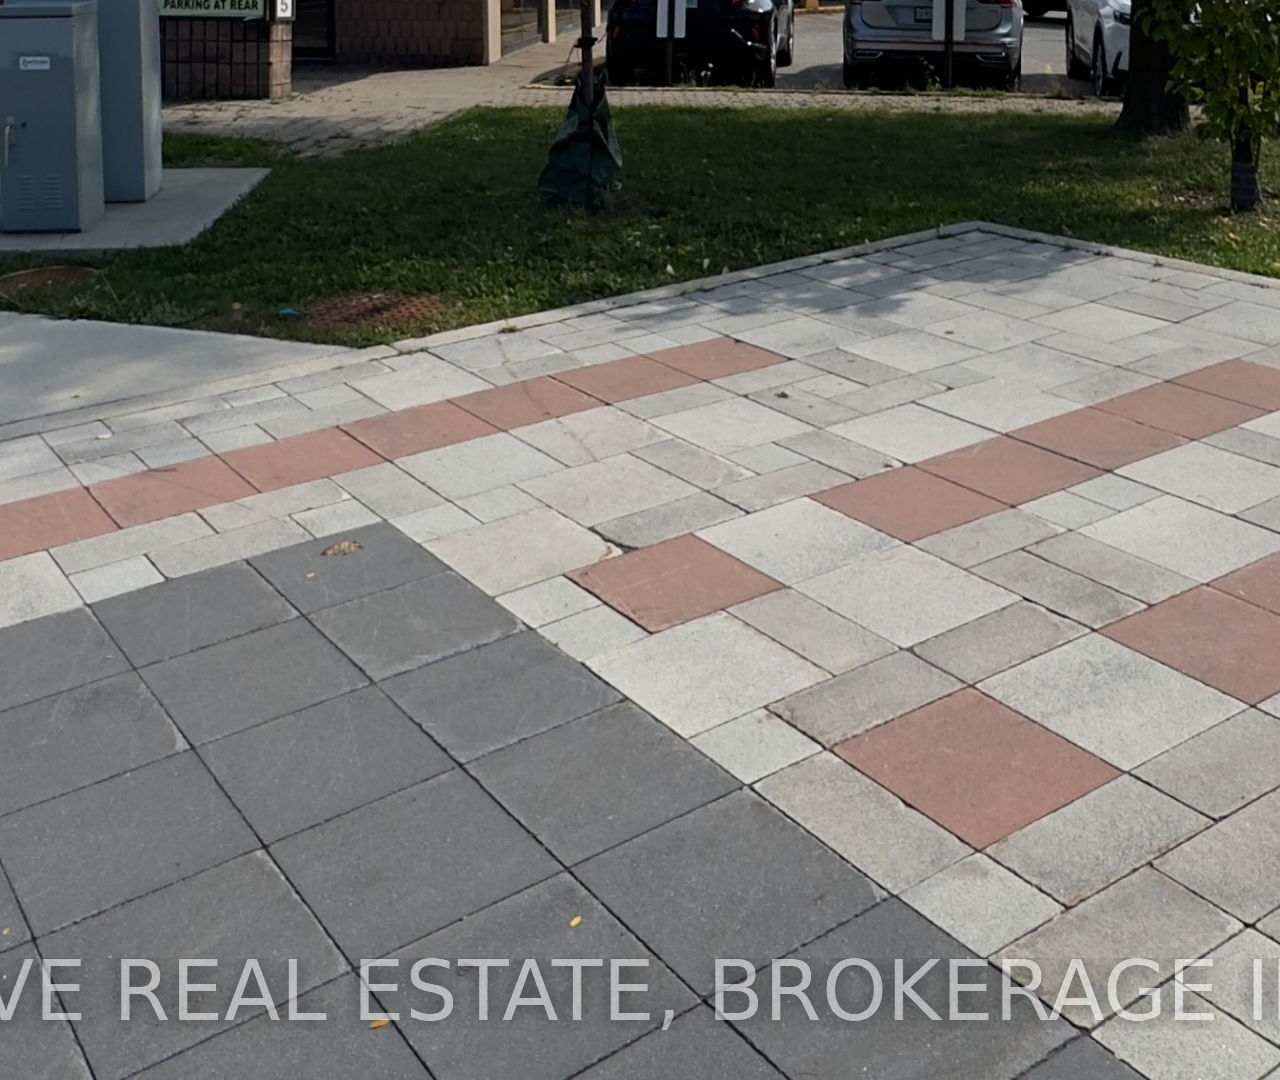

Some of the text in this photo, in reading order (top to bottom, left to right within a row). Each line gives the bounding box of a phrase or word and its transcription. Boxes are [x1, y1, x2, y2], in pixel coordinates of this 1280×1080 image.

[164, 0, 258, 10] PARKING AT REAR
